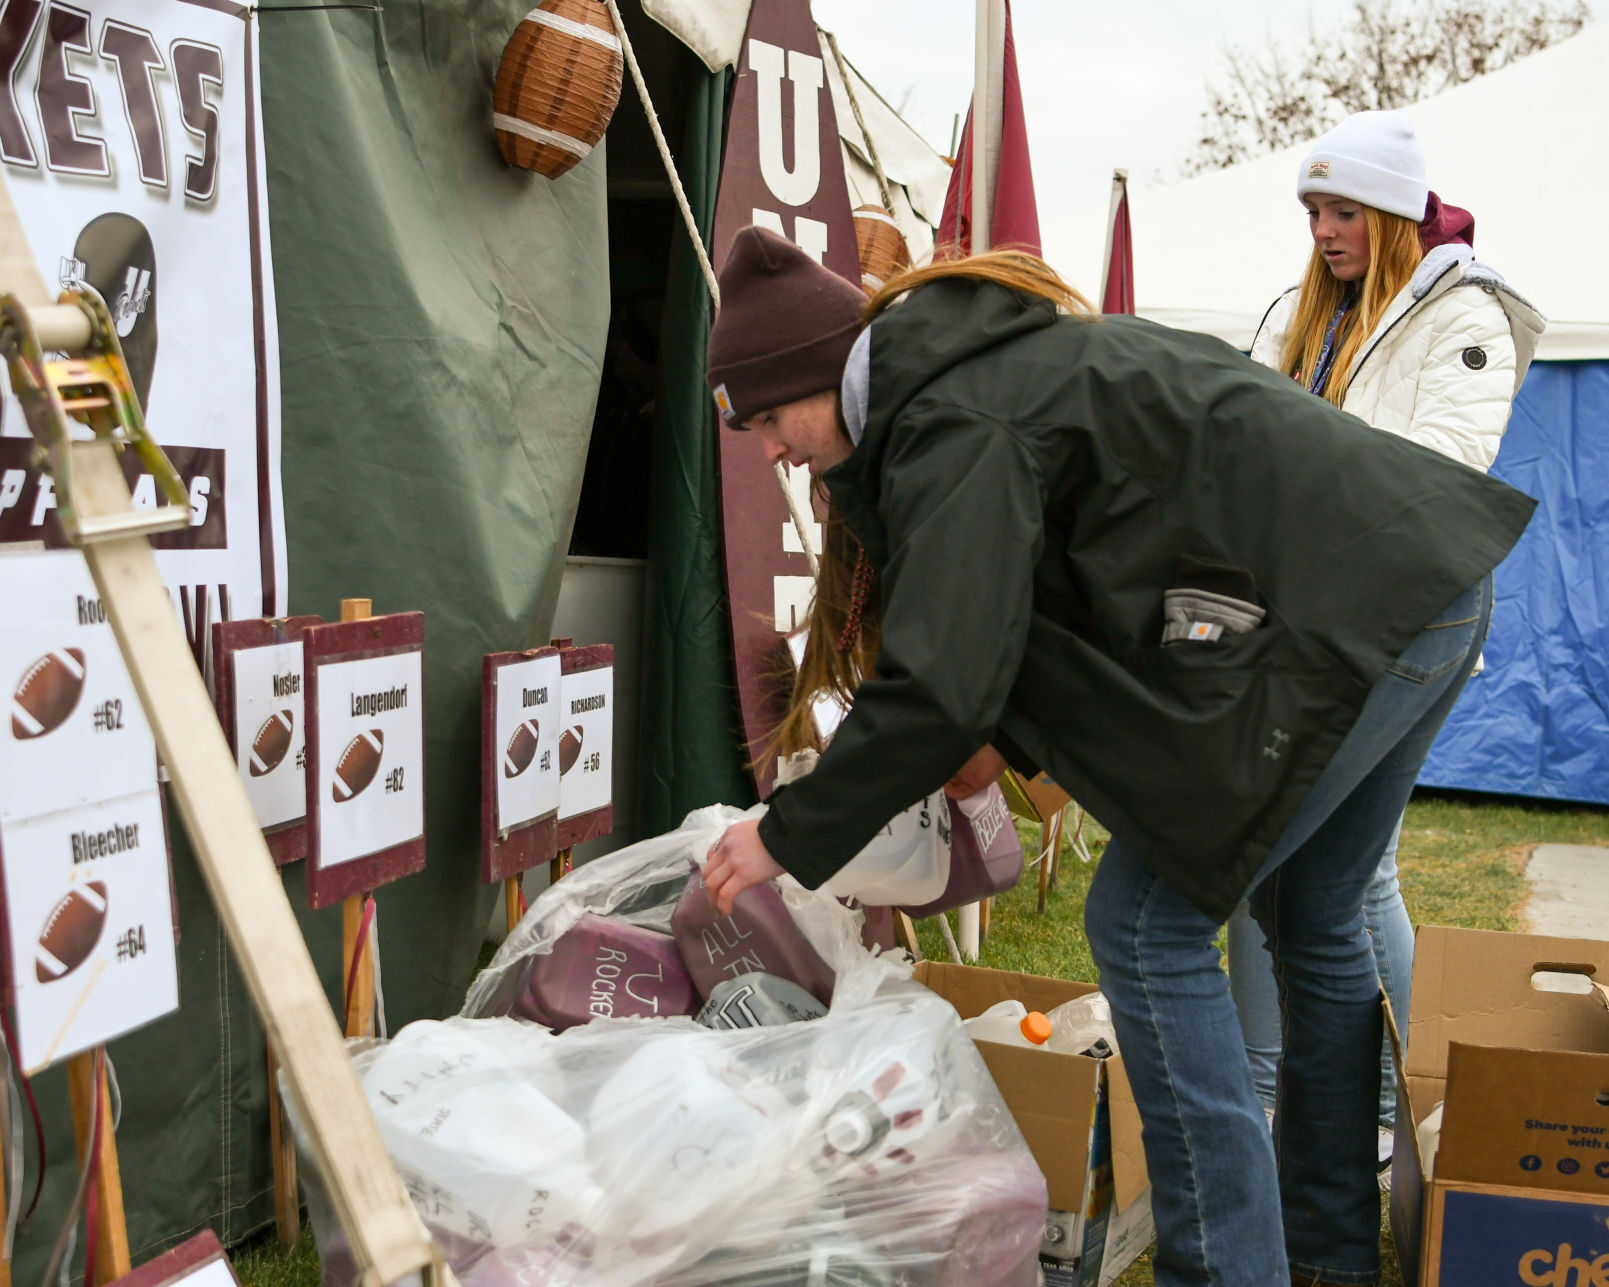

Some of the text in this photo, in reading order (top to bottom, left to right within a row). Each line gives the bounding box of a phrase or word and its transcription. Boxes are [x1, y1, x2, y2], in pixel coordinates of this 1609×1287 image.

[273, 672, 301, 698] Nosler
[522, 687, 549, 708] Duncan
[351, 683, 408, 718] Langendorf
[571, 694, 606, 715] RICHARDSON
[94, 698, 124, 734] #62
[385, 766, 405, 794] #82
[71, 823, 140, 864] Bleecher
[117, 925, 147, 963] #64
[702, 915, 752, 964] ALL
[723, 949, 766, 977] IN
[625, 963, 663, 1013] U
[1525, 1119, 1606, 1135] Share your
[1567, 1137, 1602, 1148] with
